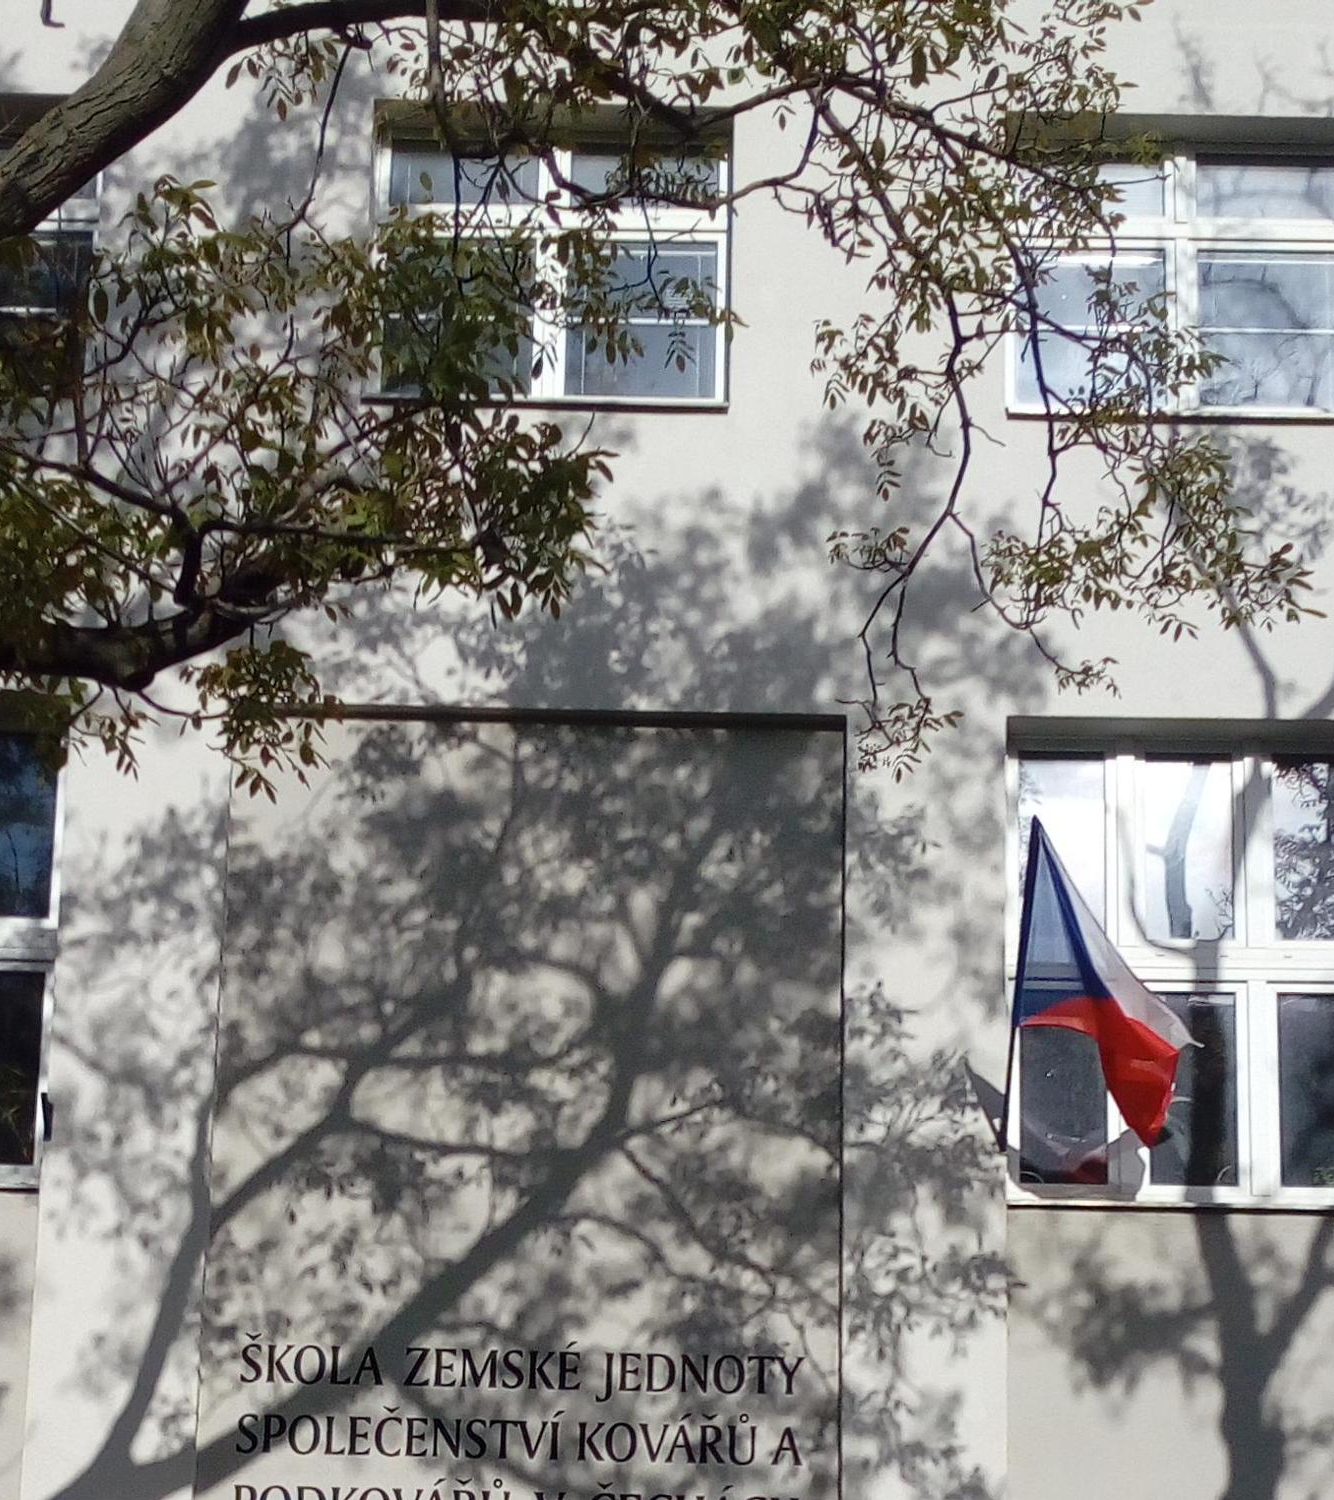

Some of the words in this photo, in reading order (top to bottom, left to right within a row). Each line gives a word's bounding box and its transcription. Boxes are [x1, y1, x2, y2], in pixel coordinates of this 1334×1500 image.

[240, 1333, 383, 1386] ŠKOLA
[405, 1341, 581, 1390] ZEMSKÉ
[596, 1353, 805, 1403] JEDNOTY
[235, 1407, 562, 1460] SPOLEČENSTVÍ
[577, 1413, 757, 1466] KOVÁŘŮ
[771, 1434, 803, 1466] A
